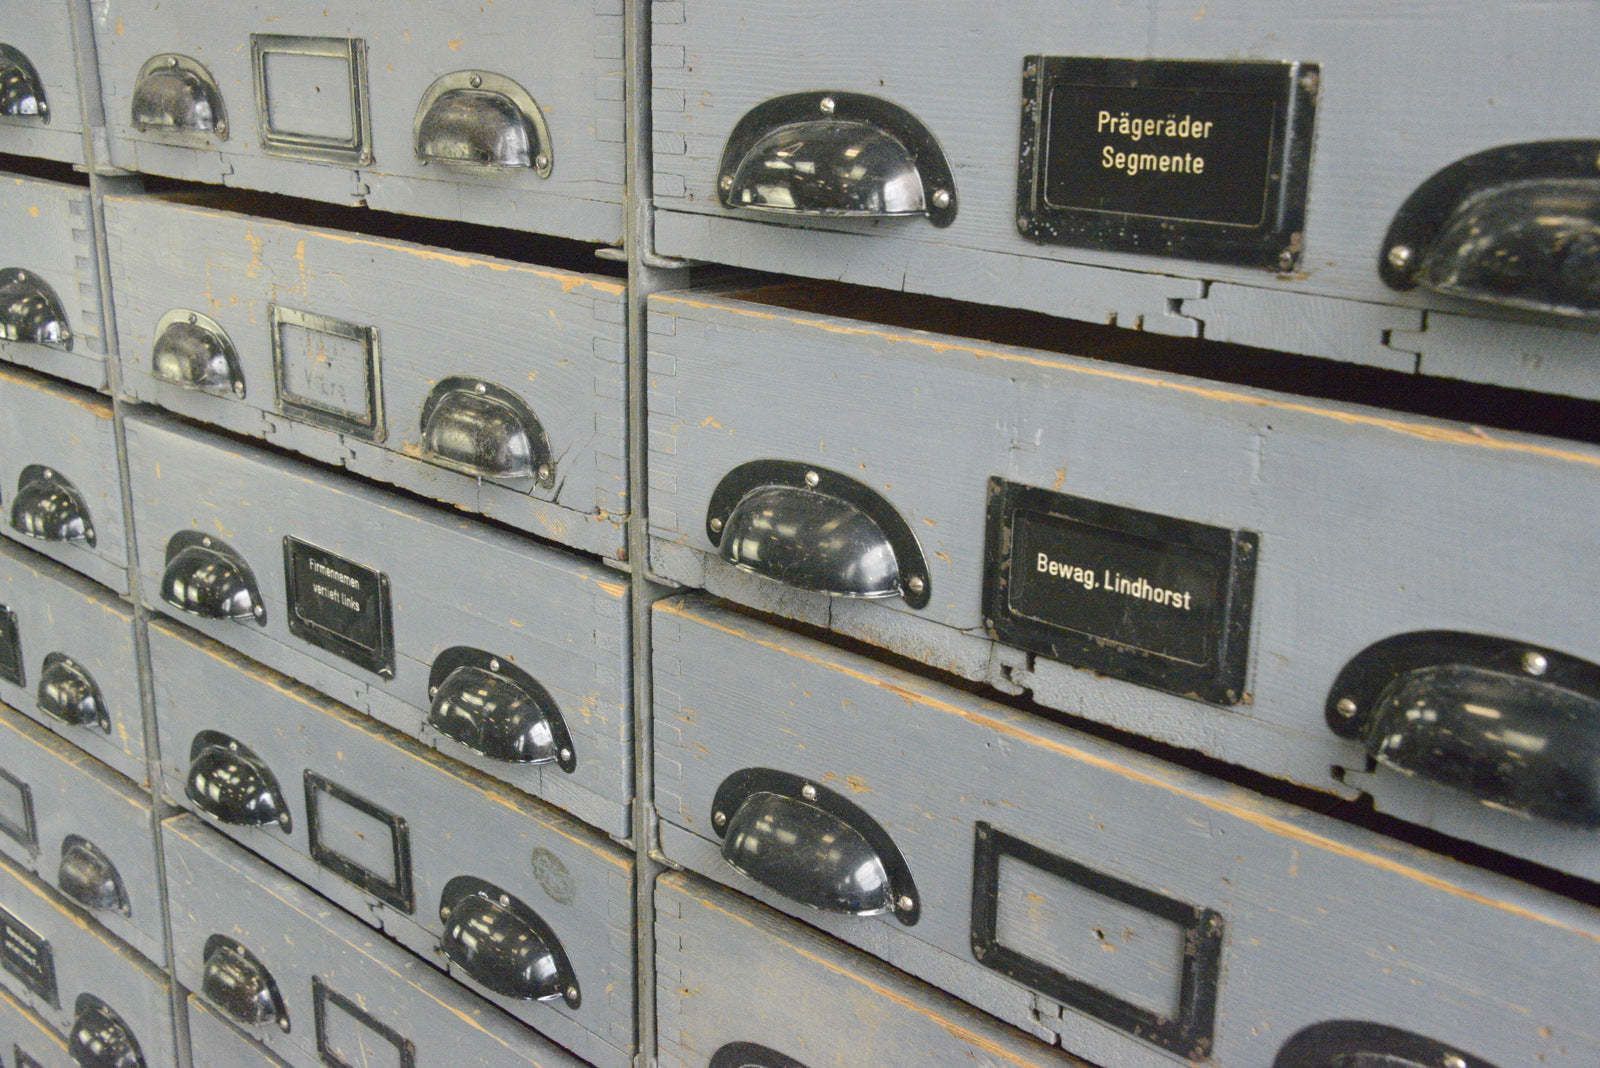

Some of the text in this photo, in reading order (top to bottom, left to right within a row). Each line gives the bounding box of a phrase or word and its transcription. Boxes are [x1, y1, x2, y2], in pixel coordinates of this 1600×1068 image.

[1097, 110, 1213, 141] Prägeräder
[1102, 145, 1205, 176] Segmente
[1036, 552, 1192, 611] Bewag. Lindhorst
